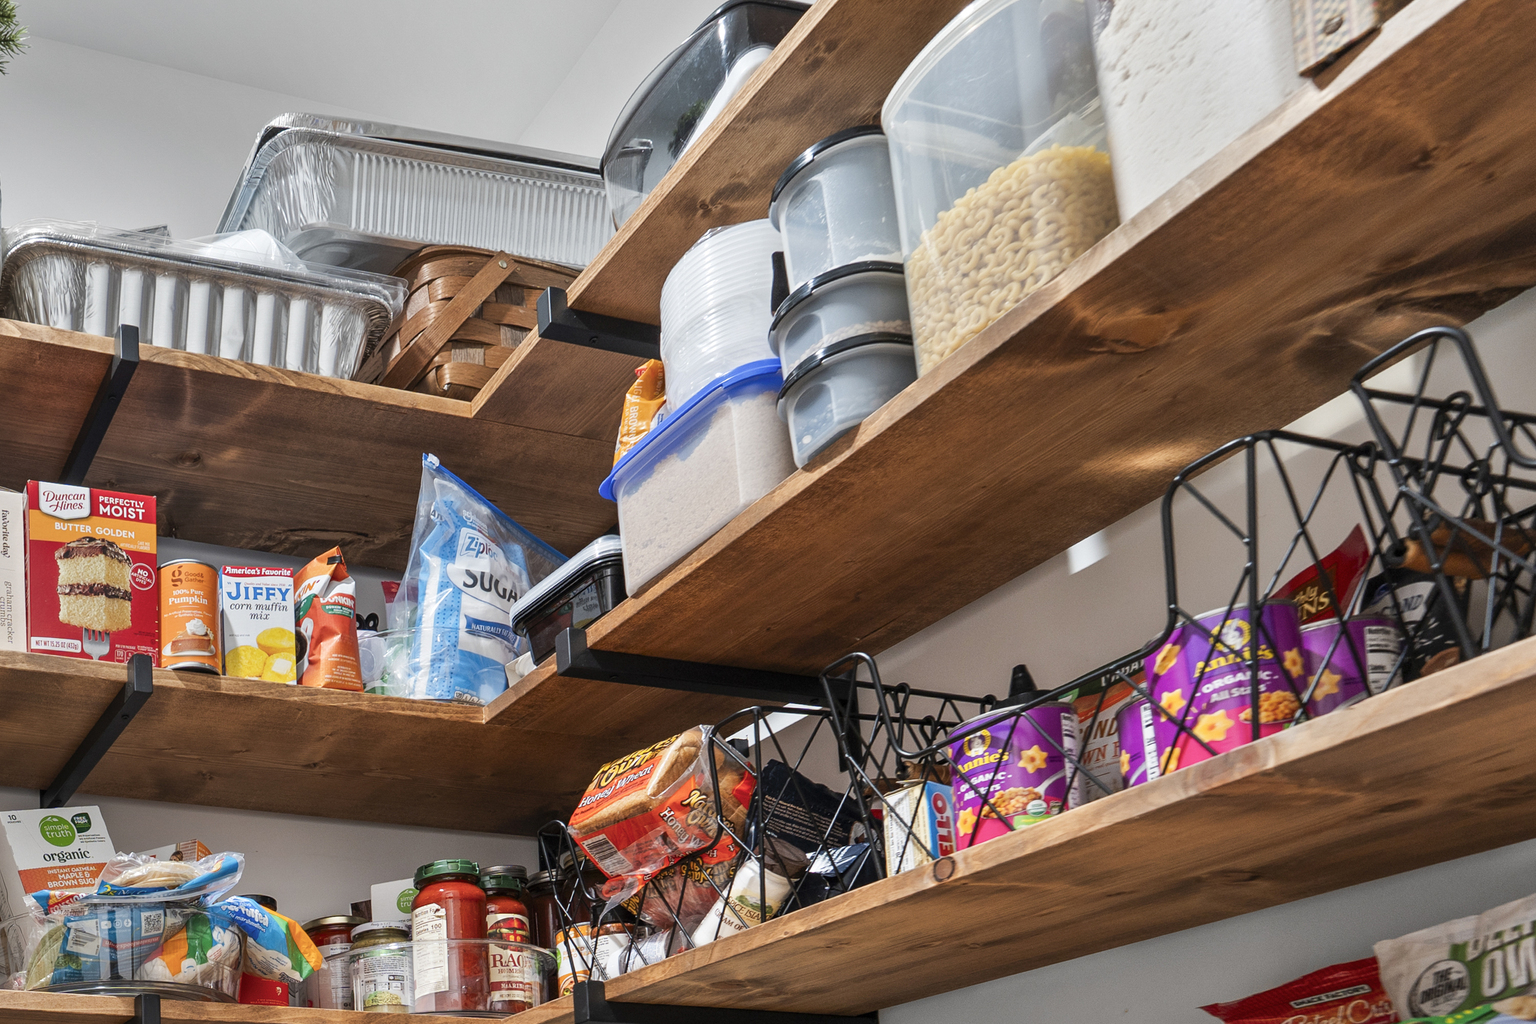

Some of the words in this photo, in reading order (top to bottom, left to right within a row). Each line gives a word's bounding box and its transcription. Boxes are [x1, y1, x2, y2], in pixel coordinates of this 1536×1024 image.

[42, 490, 85, 502] Duncan
[99, 496, 144, 508] PERFECTLY
[99, 504, 145, 520] MOIST
[55, 522, 92, 533] BUTTER
[96, 526, 135, 539] GOLDEN
[225, 566, 260, 575] America's
[226, 582, 290, 602] JIFFY
[169, 597, 208, 606] Pumpkin
[230, 603, 252, 611] corn
[254, 602, 288, 612] muffin
[250, 611, 270, 620] mix
[578, 784, 614, 808] Honey
[616, 763, 654, 790] Wheat
[44, 824, 69, 832] simple
[46, 829, 72, 838] truth
[43, 848, 90, 863] organic
[1421, 979, 1467, 1005] ORIGINAL
